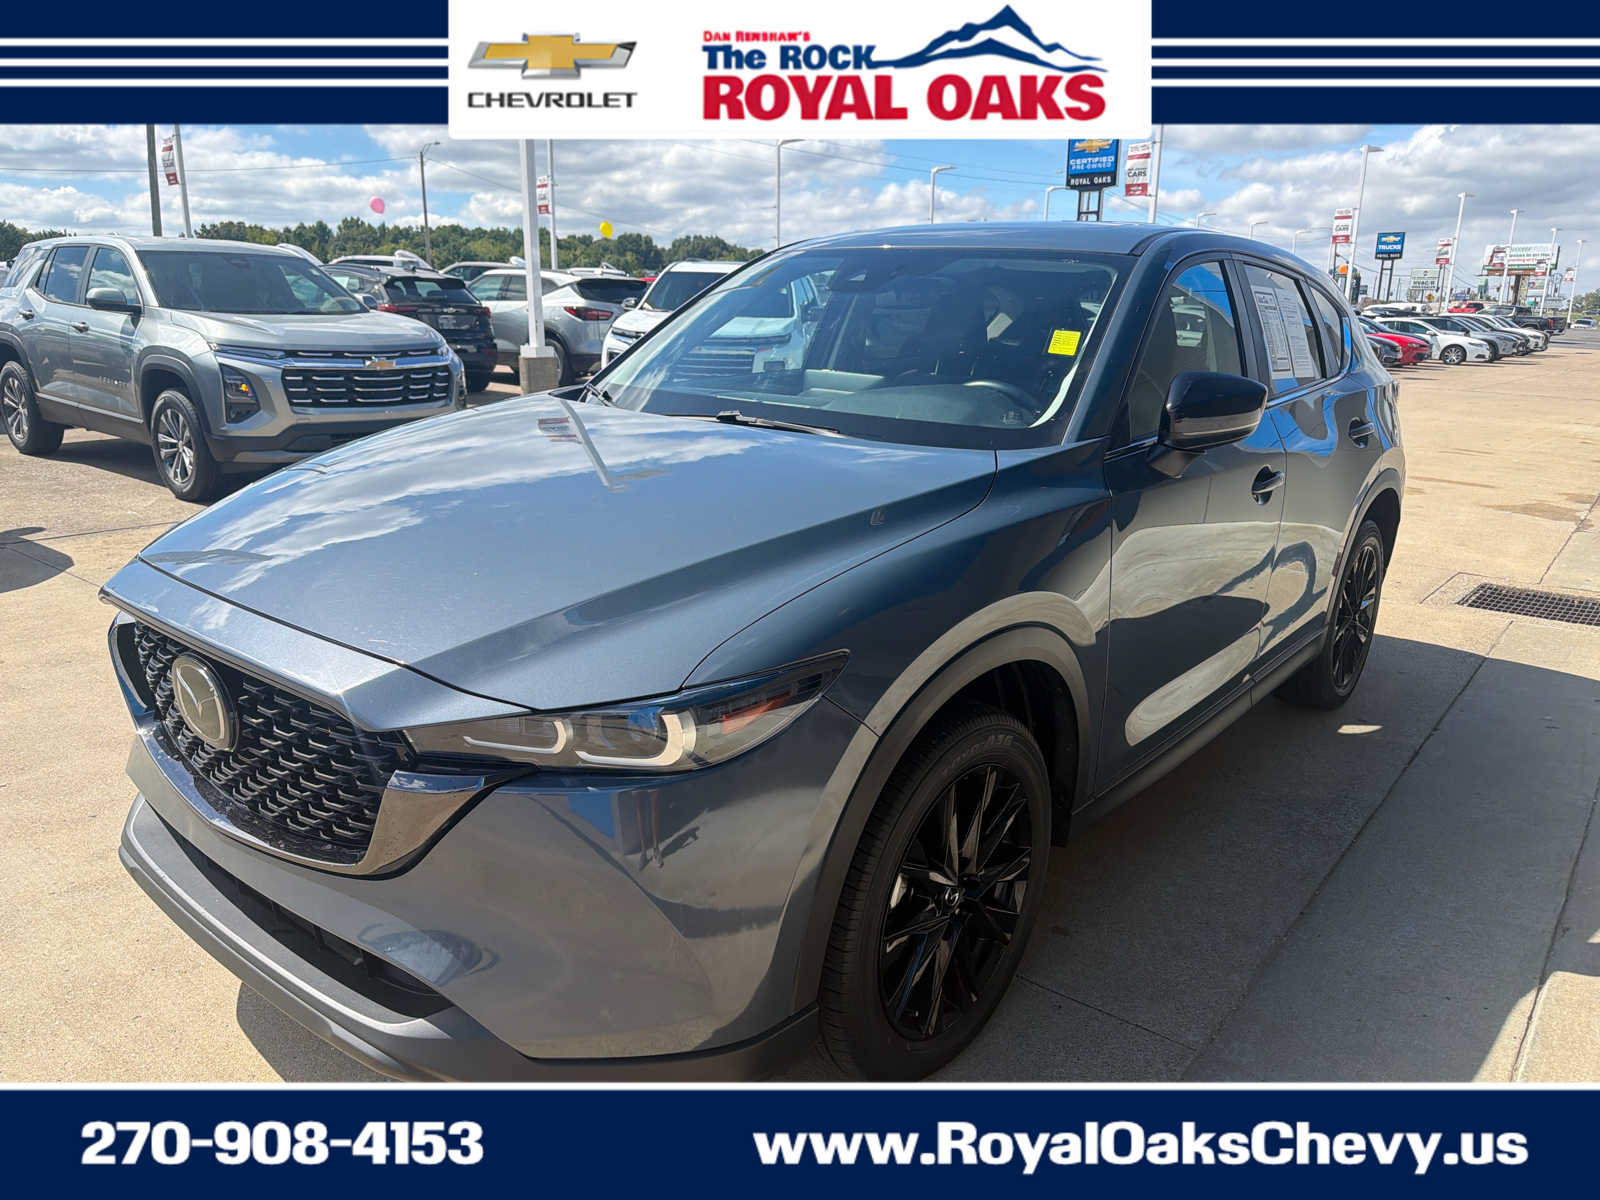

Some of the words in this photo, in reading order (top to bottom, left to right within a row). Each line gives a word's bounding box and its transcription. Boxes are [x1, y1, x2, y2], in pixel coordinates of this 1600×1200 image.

[1070, 156, 1114, 165] CERTIFIED
[1127, 170, 1147, 178] CARS
[1070, 177, 1091, 186] ROYAL
[1093, 176, 1112, 184] OAKS
